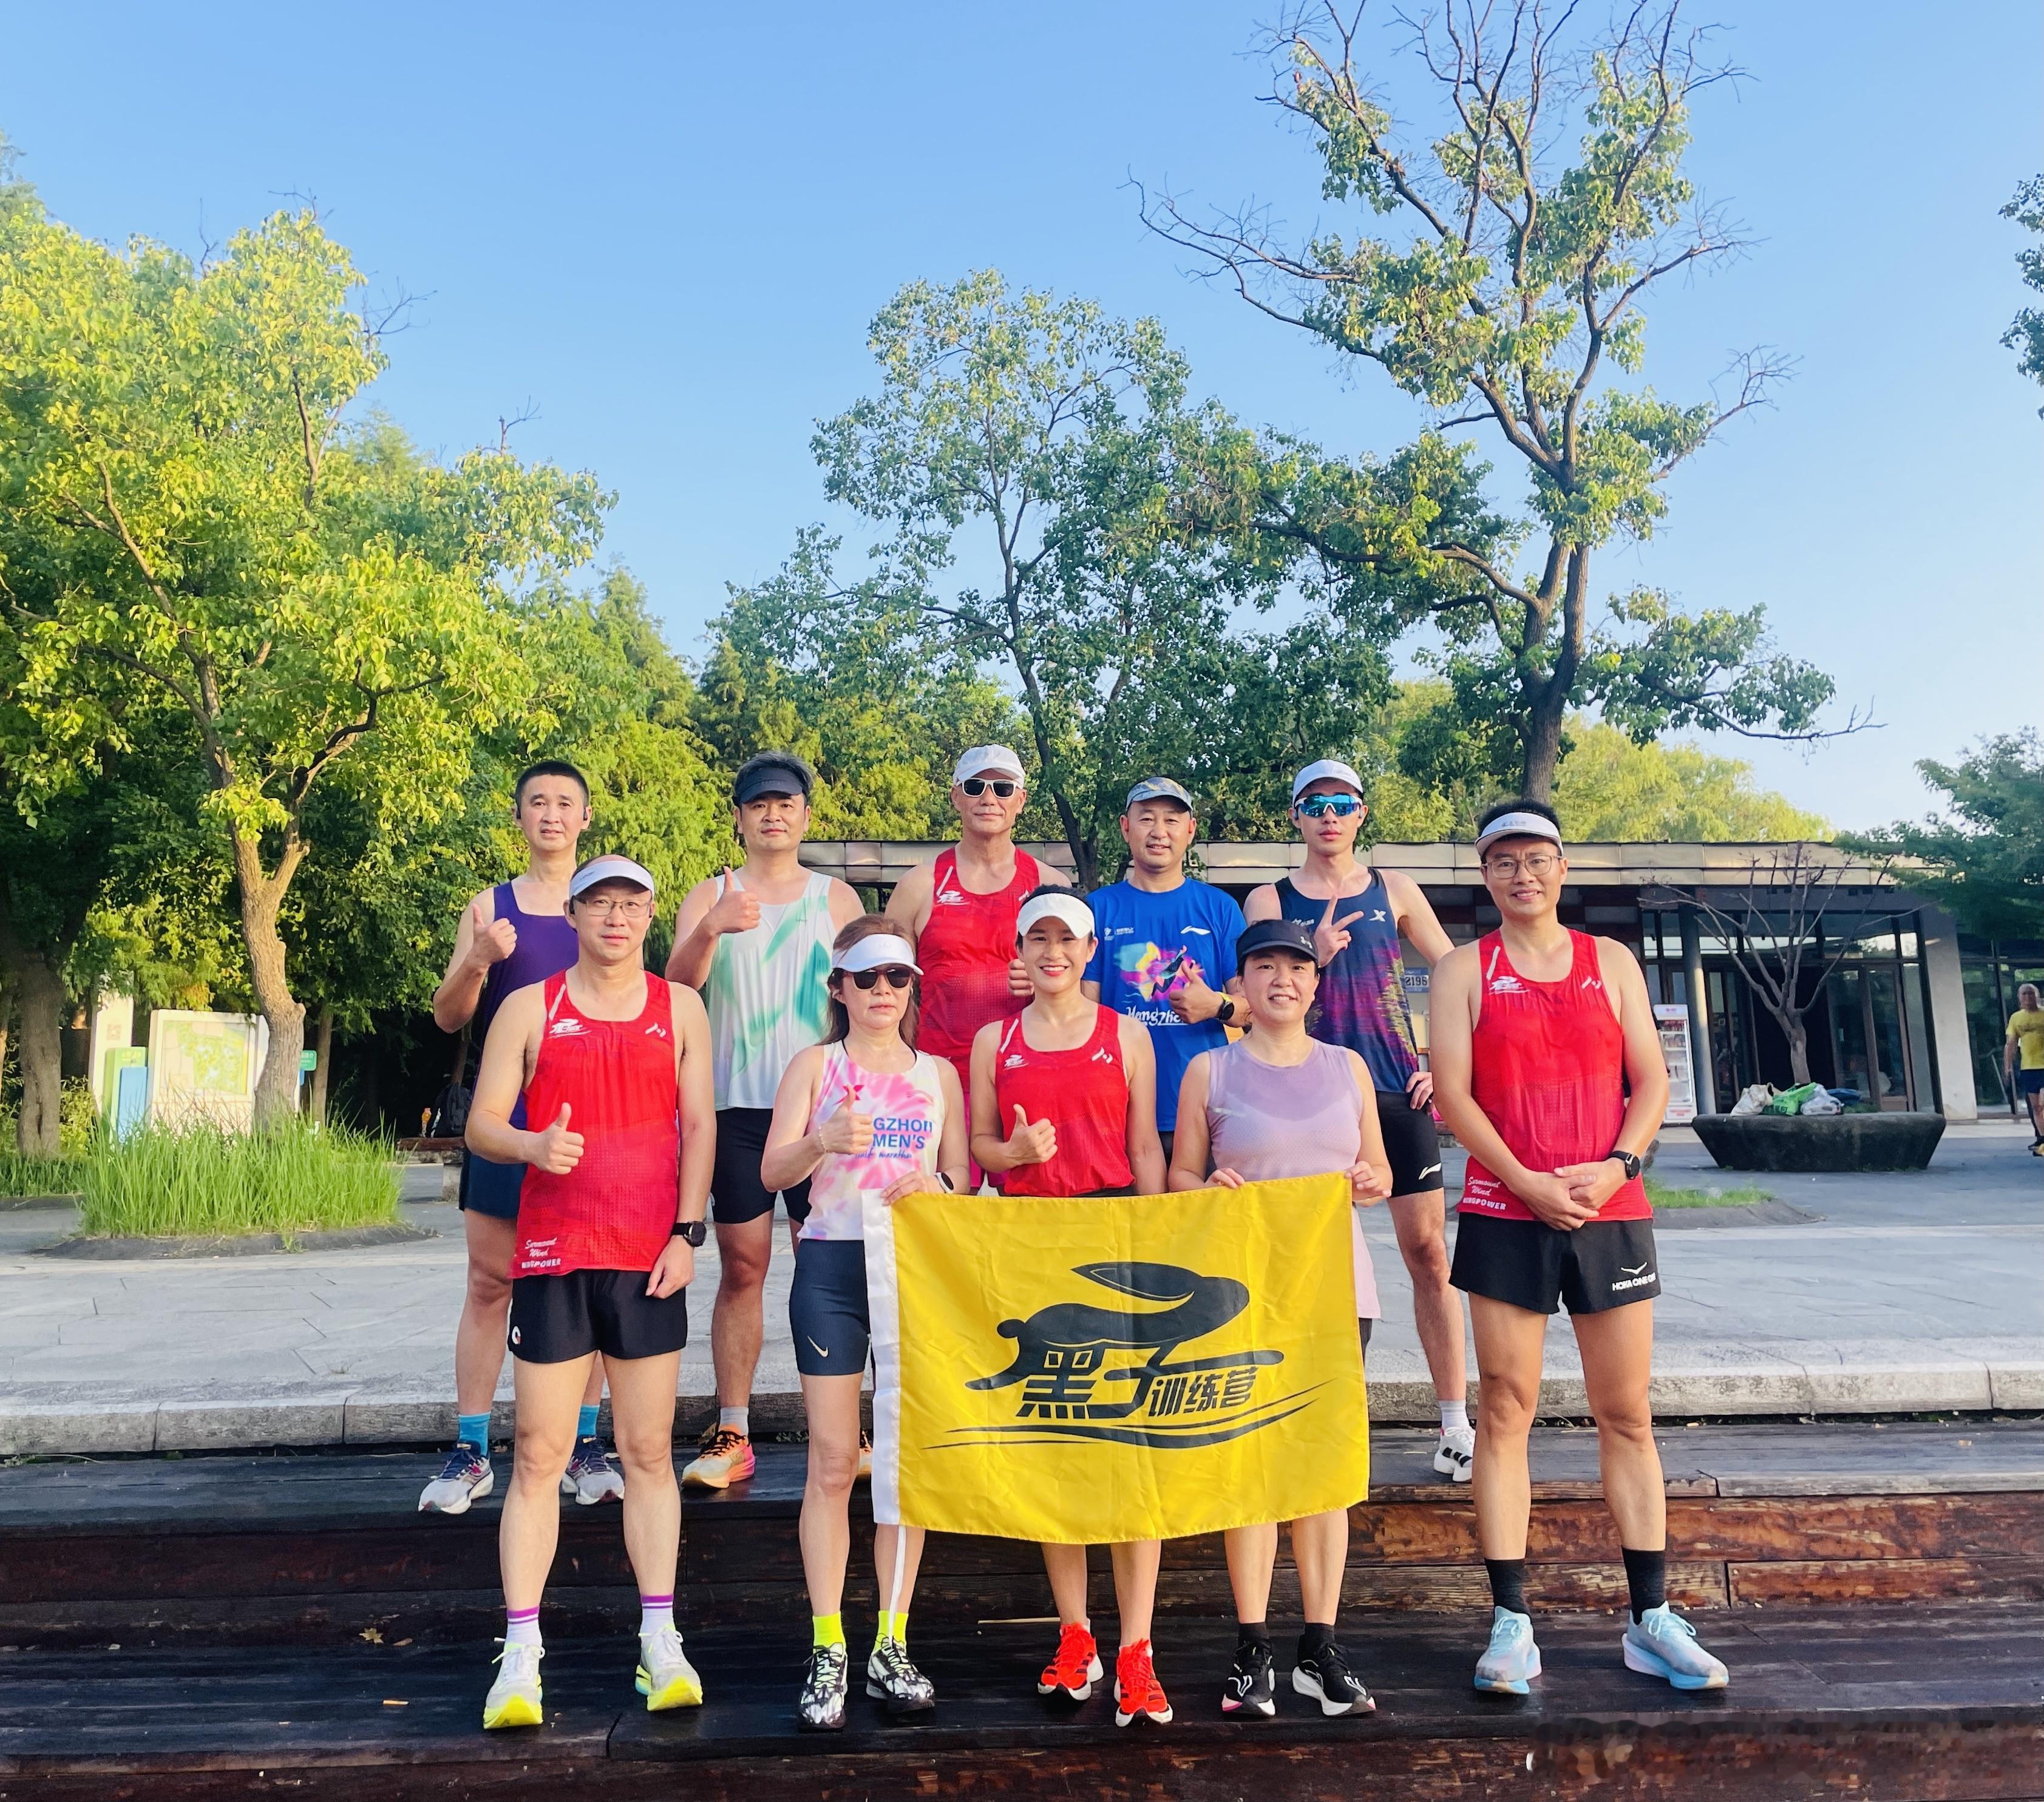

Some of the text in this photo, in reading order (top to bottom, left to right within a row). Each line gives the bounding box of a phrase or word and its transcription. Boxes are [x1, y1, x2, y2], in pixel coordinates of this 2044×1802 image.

[1405, 976, 1427, 986] 2196
[1126, 1005, 1184, 1026] Hangzho
[872, 1134, 925, 1149] MEN'S
[1612, 1279, 1633, 1291] HOKA
[1149, 1367, 1258, 1417] 训练营
